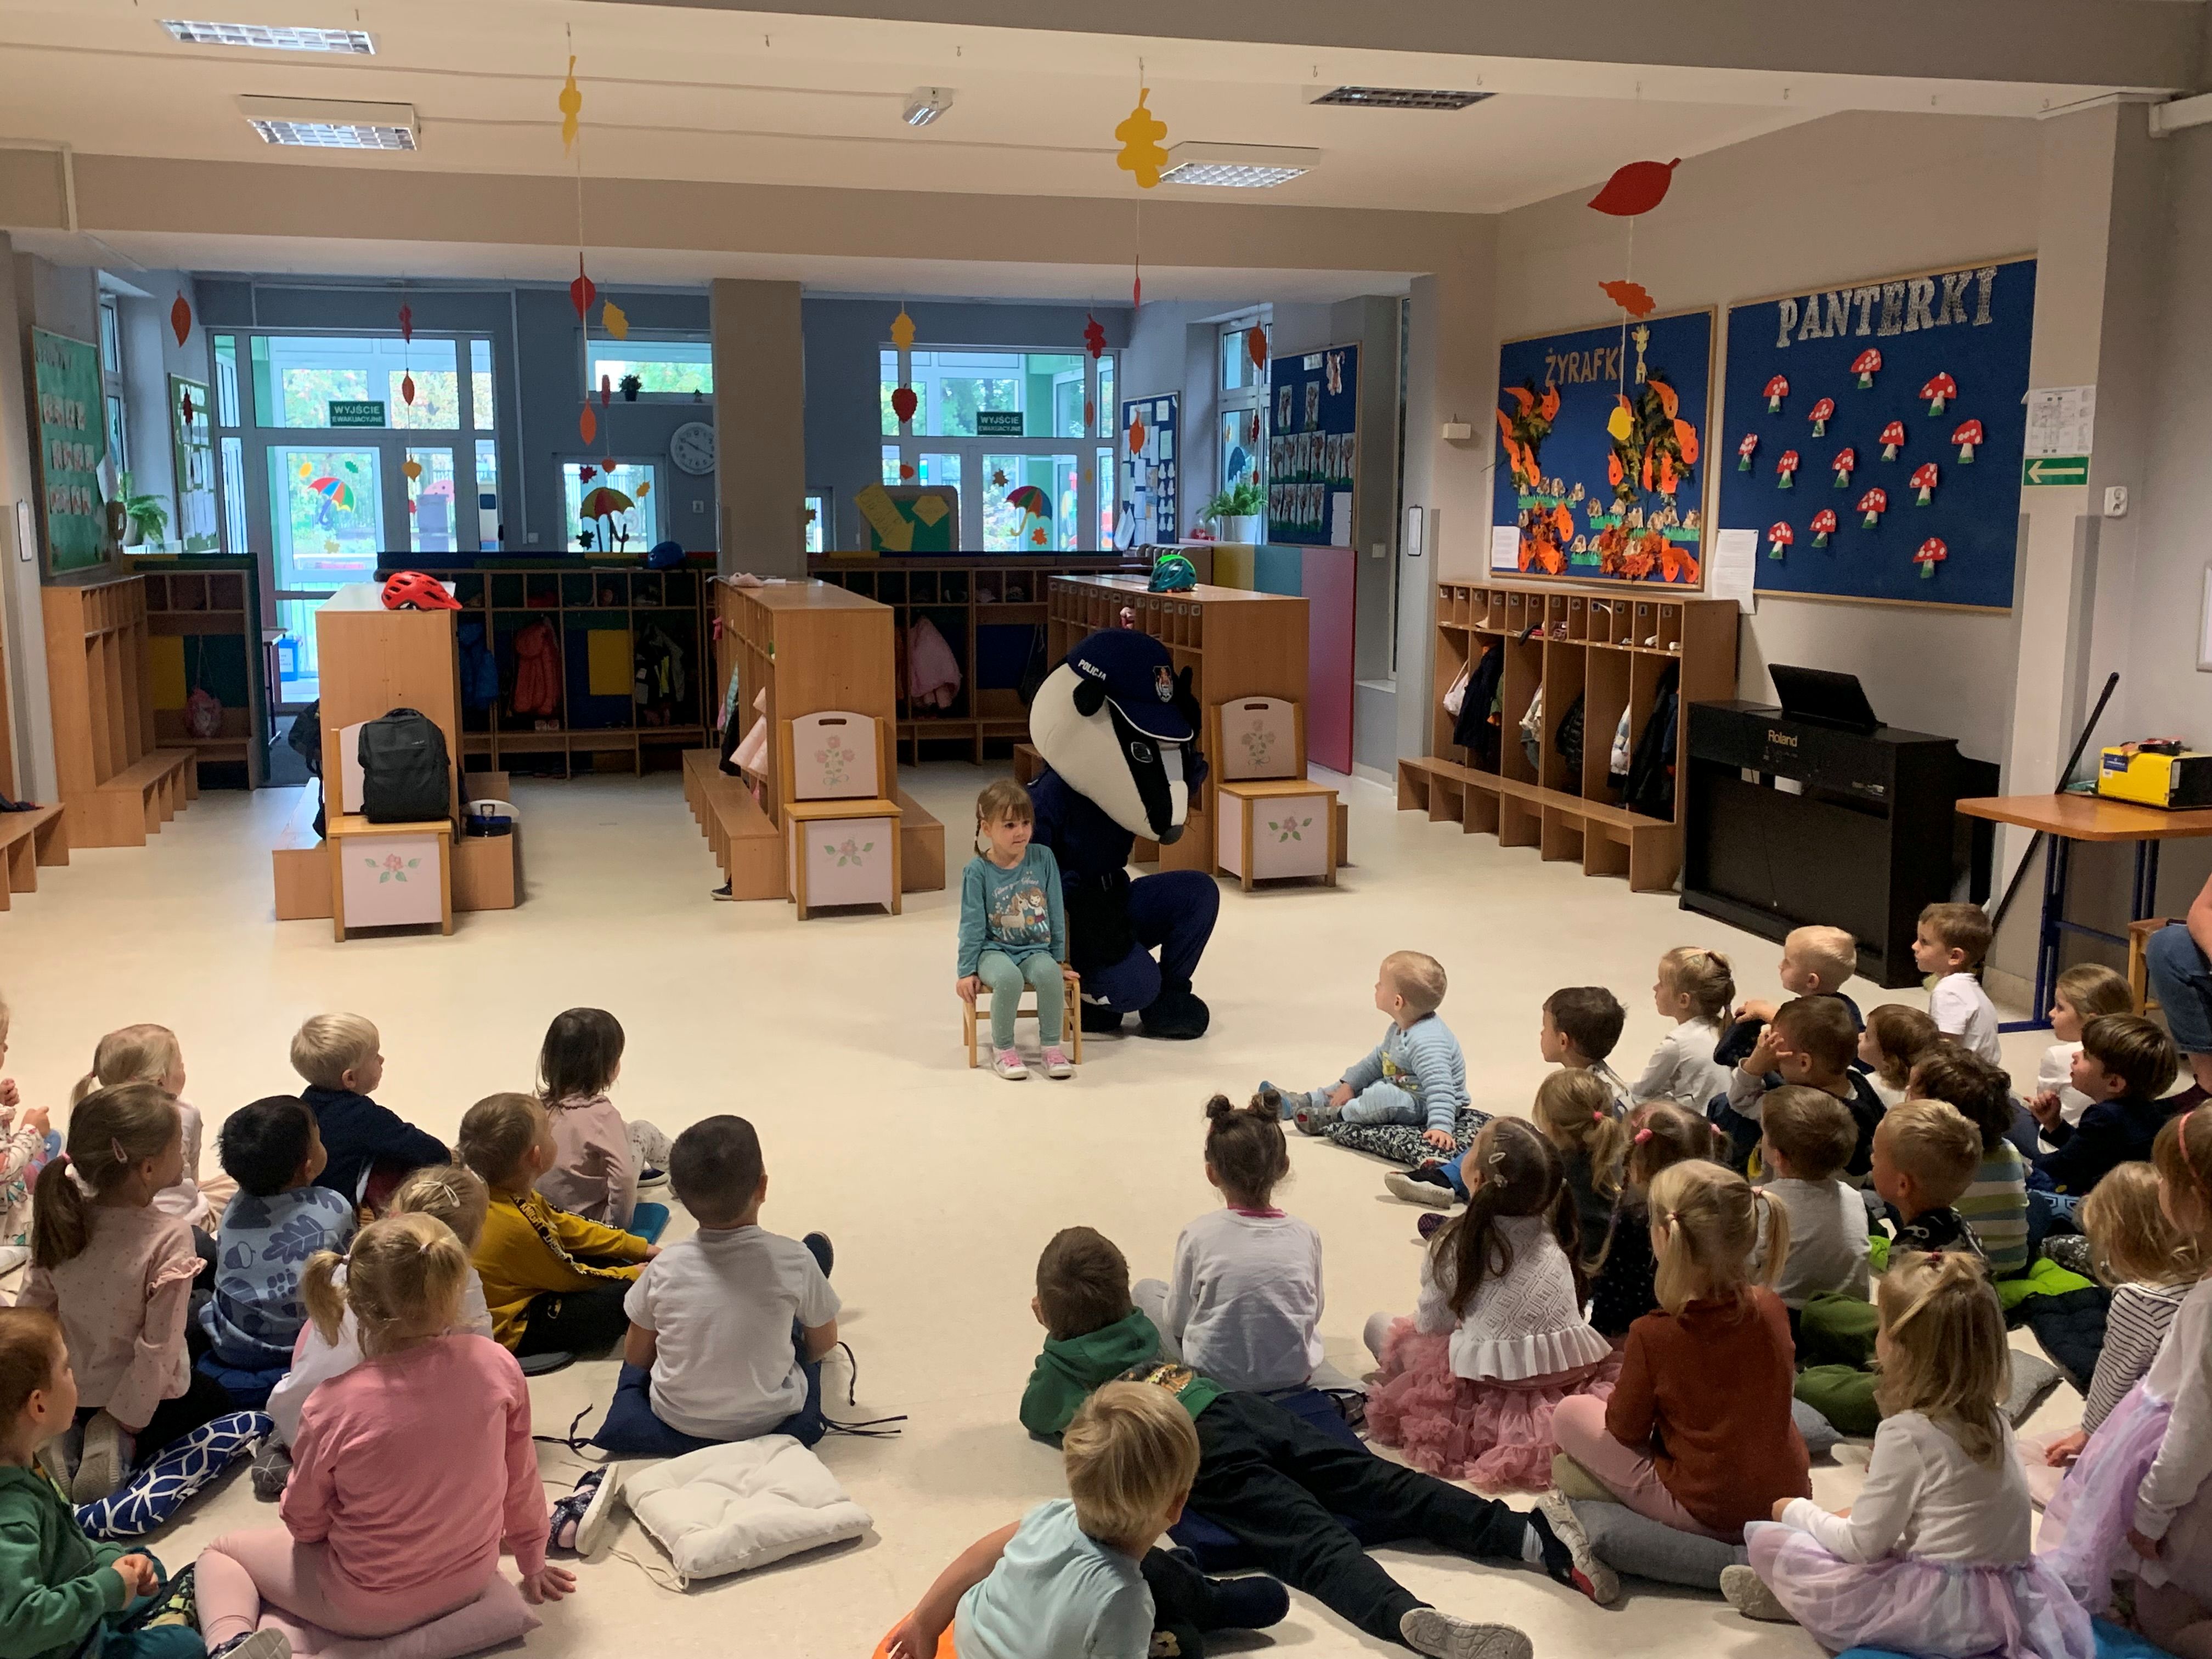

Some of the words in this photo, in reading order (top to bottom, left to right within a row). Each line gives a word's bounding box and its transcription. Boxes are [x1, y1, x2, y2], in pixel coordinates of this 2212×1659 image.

[1776, 266, 1997, 348] PANTERKI
[334, 404, 380, 414] WYJŚCIE
[980, 415, 1019, 424] WYJŚCIE
[1768, 730, 1797, 747] Roland
